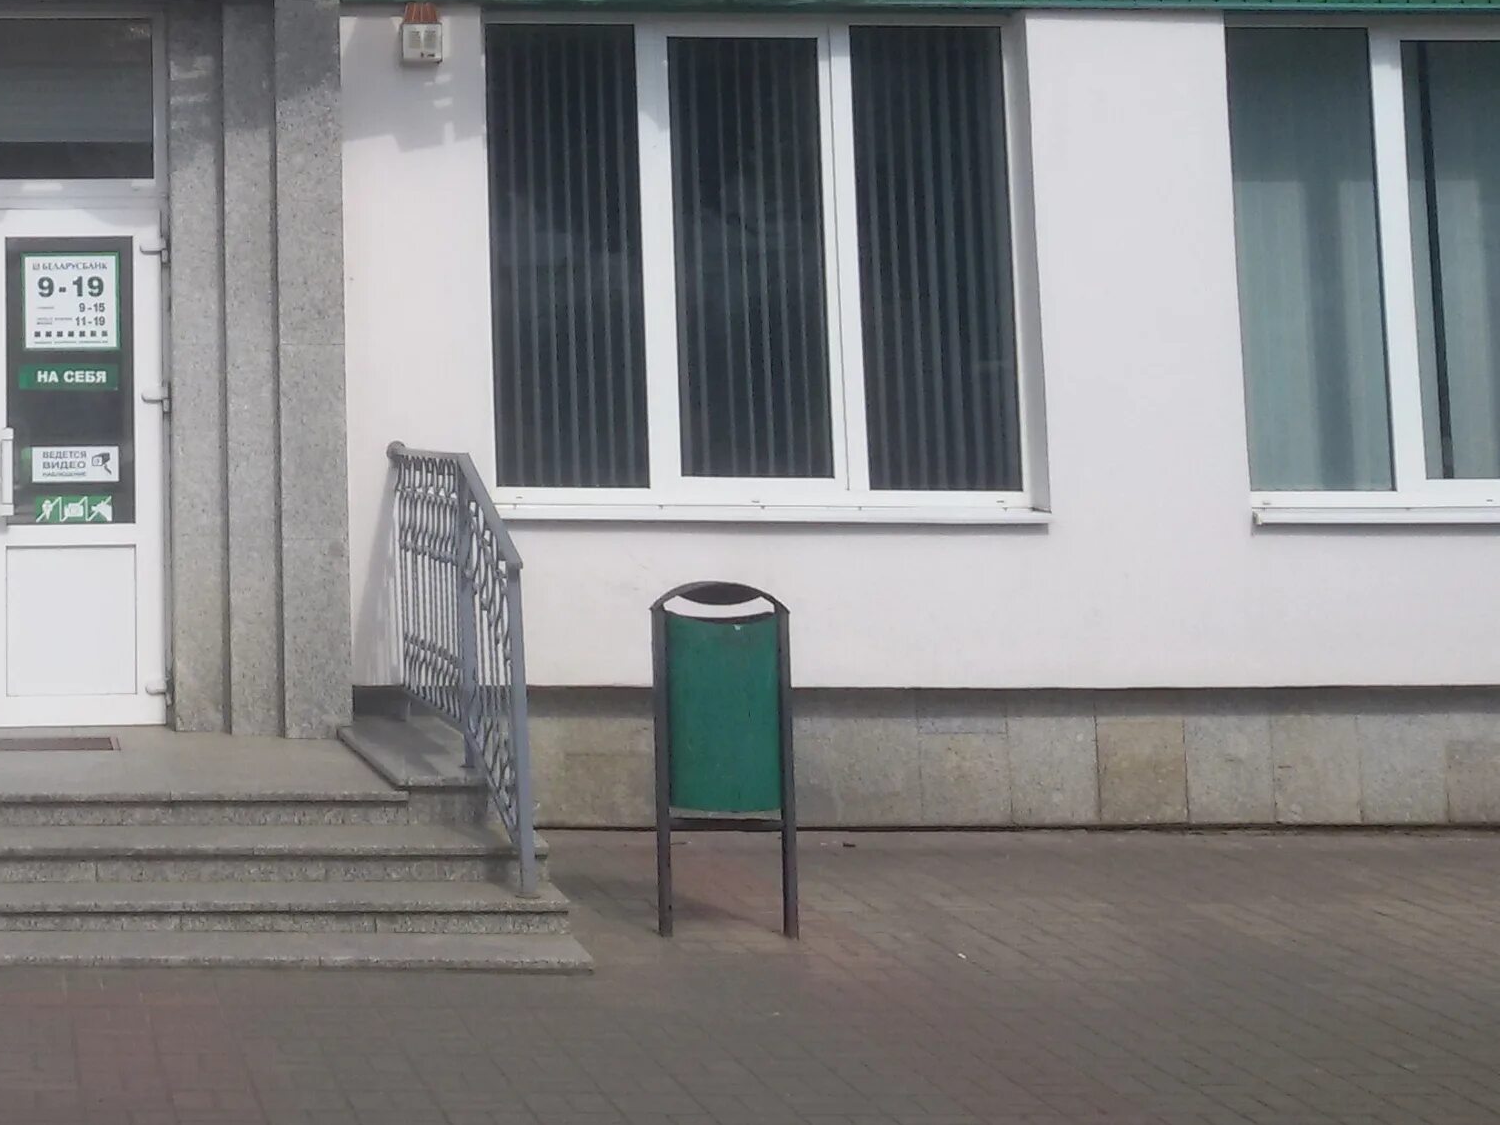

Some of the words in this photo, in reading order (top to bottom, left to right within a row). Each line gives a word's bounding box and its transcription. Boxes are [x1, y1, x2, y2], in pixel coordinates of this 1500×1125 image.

[42, 262, 108, 271] БЕЛАРУСБАНК
[36, 370, 59, 383] НА
[63, 370, 107, 383] СЕБЯ
[42, 461, 87, 470] ВИДЕО
